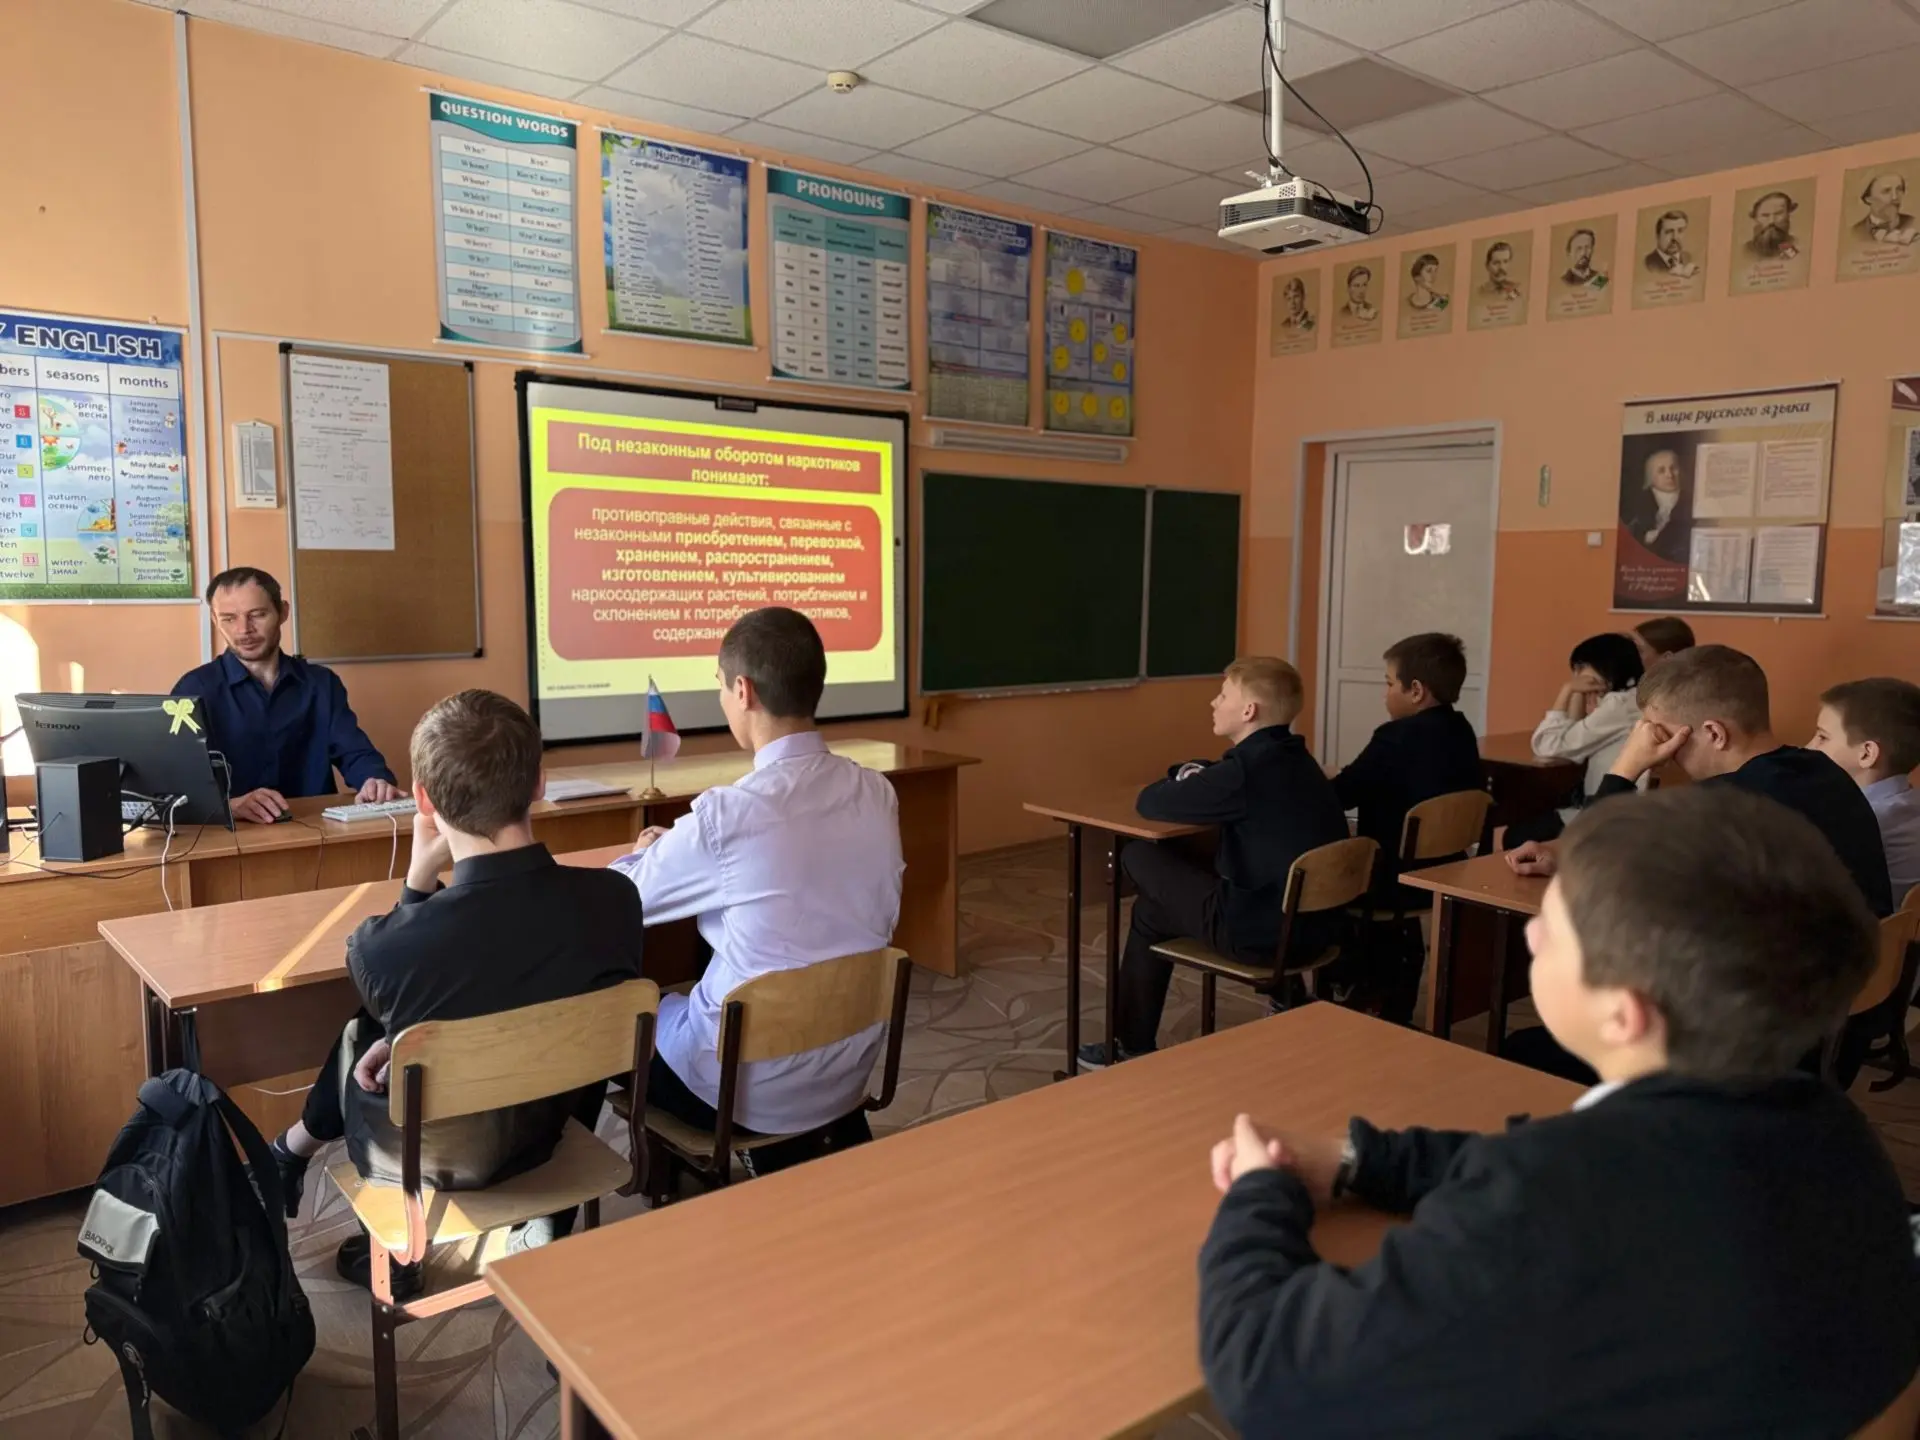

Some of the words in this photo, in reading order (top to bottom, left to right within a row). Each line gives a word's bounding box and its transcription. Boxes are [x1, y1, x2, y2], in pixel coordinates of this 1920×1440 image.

[440, 100, 512, 126] QUESTION
[516, 117, 569, 138] WORDS
[796, 179, 885, 210] PRONOUNS
[15, 324, 162, 360] ENGLISH
[46, 368, 100, 383] seasons
[119, 376, 169, 389] months
[1644, 411, 1654, 424] В
[1657, 412, 1692, 425] мире
[1694, 405, 1758, 424] русского
[1760, 401, 1811, 419] языка
[578, 432, 612, 454] Под
[616, 440, 711, 460] незаконным
[715, 446, 784, 466] оборотом
[787, 455, 861, 472] наркотиков
[691, 468, 770, 486] понимают:
[48, 502, 79, 510] осень
[592, 508, 710, 527] противоправные
[713, 512, 776, 531] действия,
[779, 516, 842, 532] связанные
[844, 520, 852, 532] с
[574, 526, 672, 543] незаконными
[675, 530, 787, 550] приобретением,
[790, 535, 865, 551] перевозкой,
[616, 548, 702, 566] хранением,
[706, 552, 834, 568] распространением,
[0, 571, 35, 579] twelve
[602, 568, 718, 584] изготовлением,
[722, 570, 845, 587] культивированием
[572, 588, 703, 605] наркосодержащих
[708, 587, 770, 605] растений,
[773, 587, 857, 605] потреблением
[860, 590, 868, 601] и
[593, 608, 681, 622] склонением
[684, 608, 691, 621] к
[35, 720, 80, 731] lenovo
